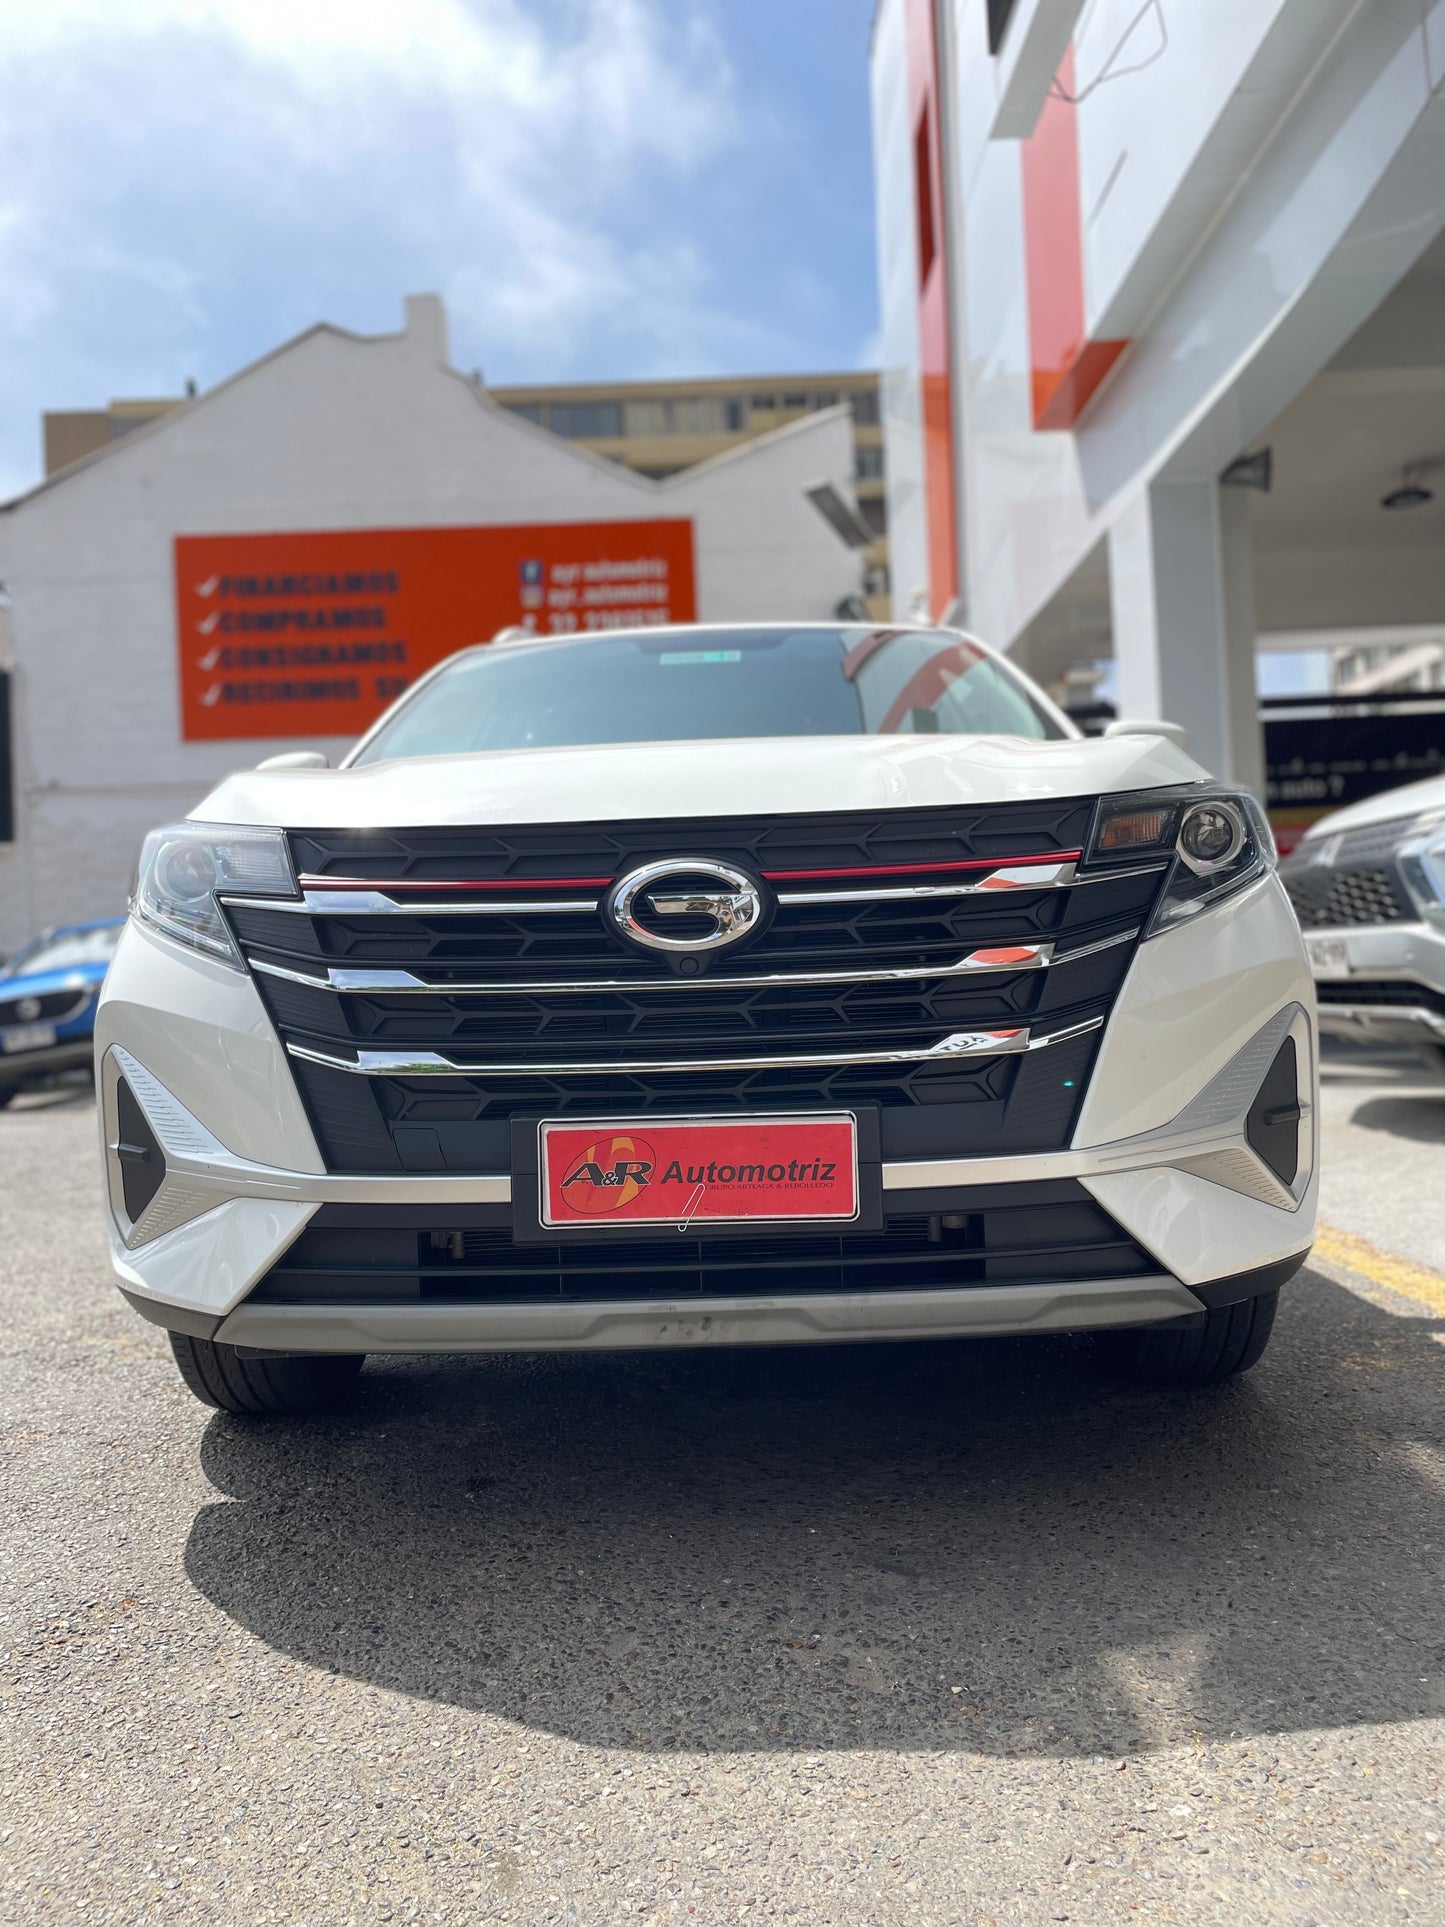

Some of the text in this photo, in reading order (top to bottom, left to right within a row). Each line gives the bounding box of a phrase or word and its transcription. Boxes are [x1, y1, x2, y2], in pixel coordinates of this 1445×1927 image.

[219, 571, 399, 598] FINANCIAMOS
[220, 605, 385, 632] COMPRAMOS
[220, 641, 407, 669] CONSIGNAMOS
[222, 677, 360, 703] RECIBIMOS
[560, 1158, 836, 1188] A&R Automotriz
